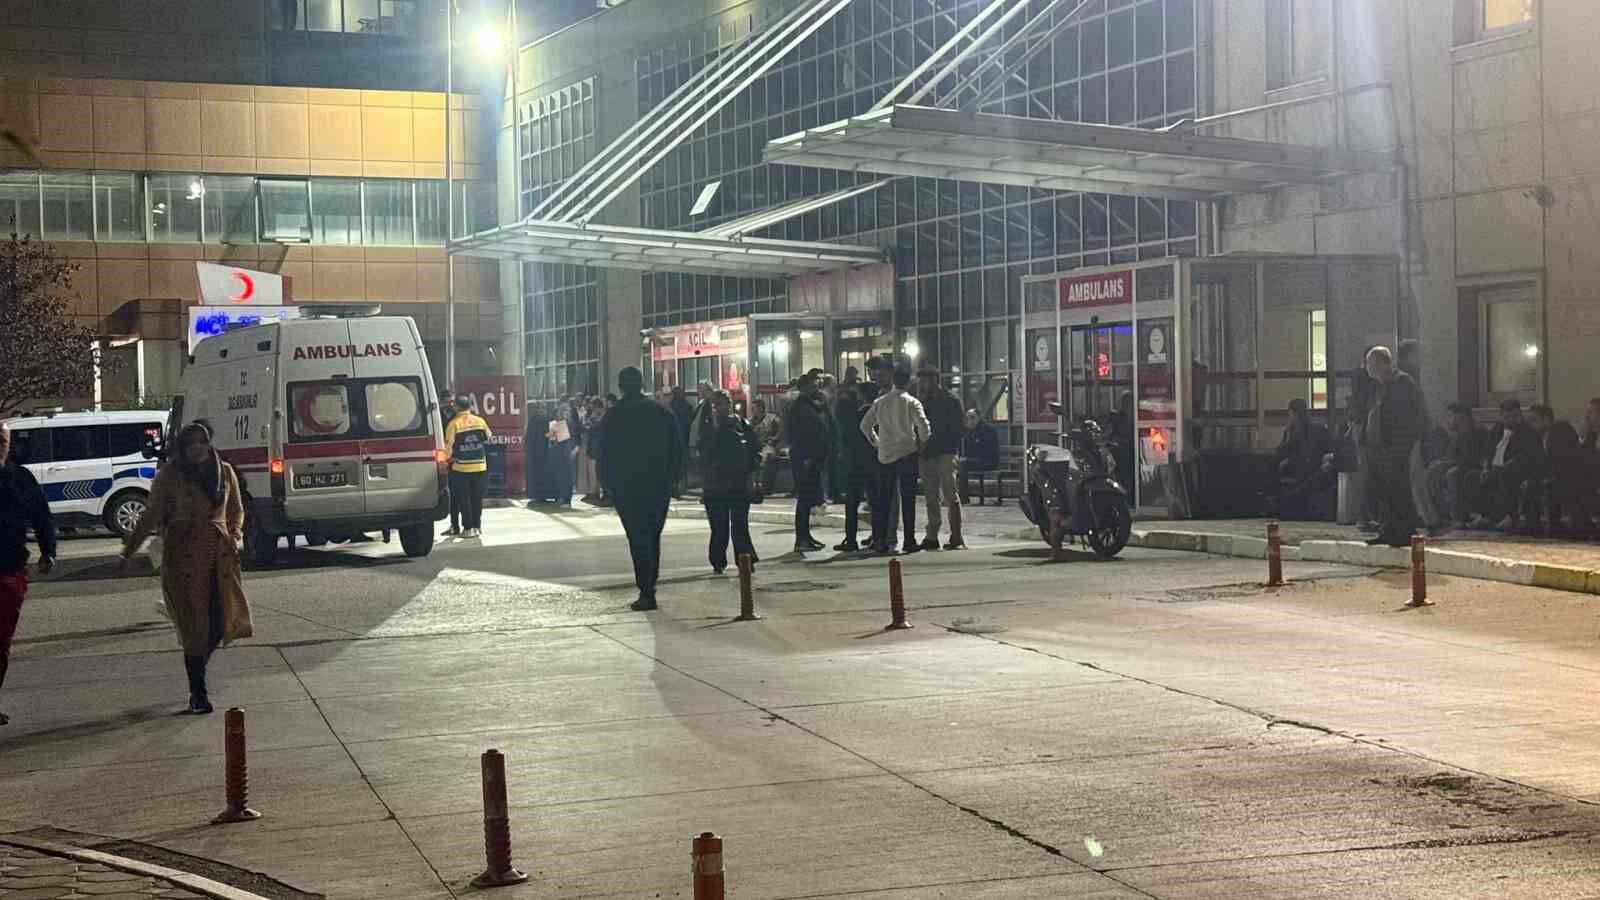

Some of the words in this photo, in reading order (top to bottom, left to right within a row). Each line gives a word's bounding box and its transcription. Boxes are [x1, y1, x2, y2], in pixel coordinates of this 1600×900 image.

[1068, 278, 1125, 302] AMBULANS
[293, 342, 402, 360] AMBULANS
[468, 386, 521, 415] ACİL
[234, 415, 249, 440] 112
